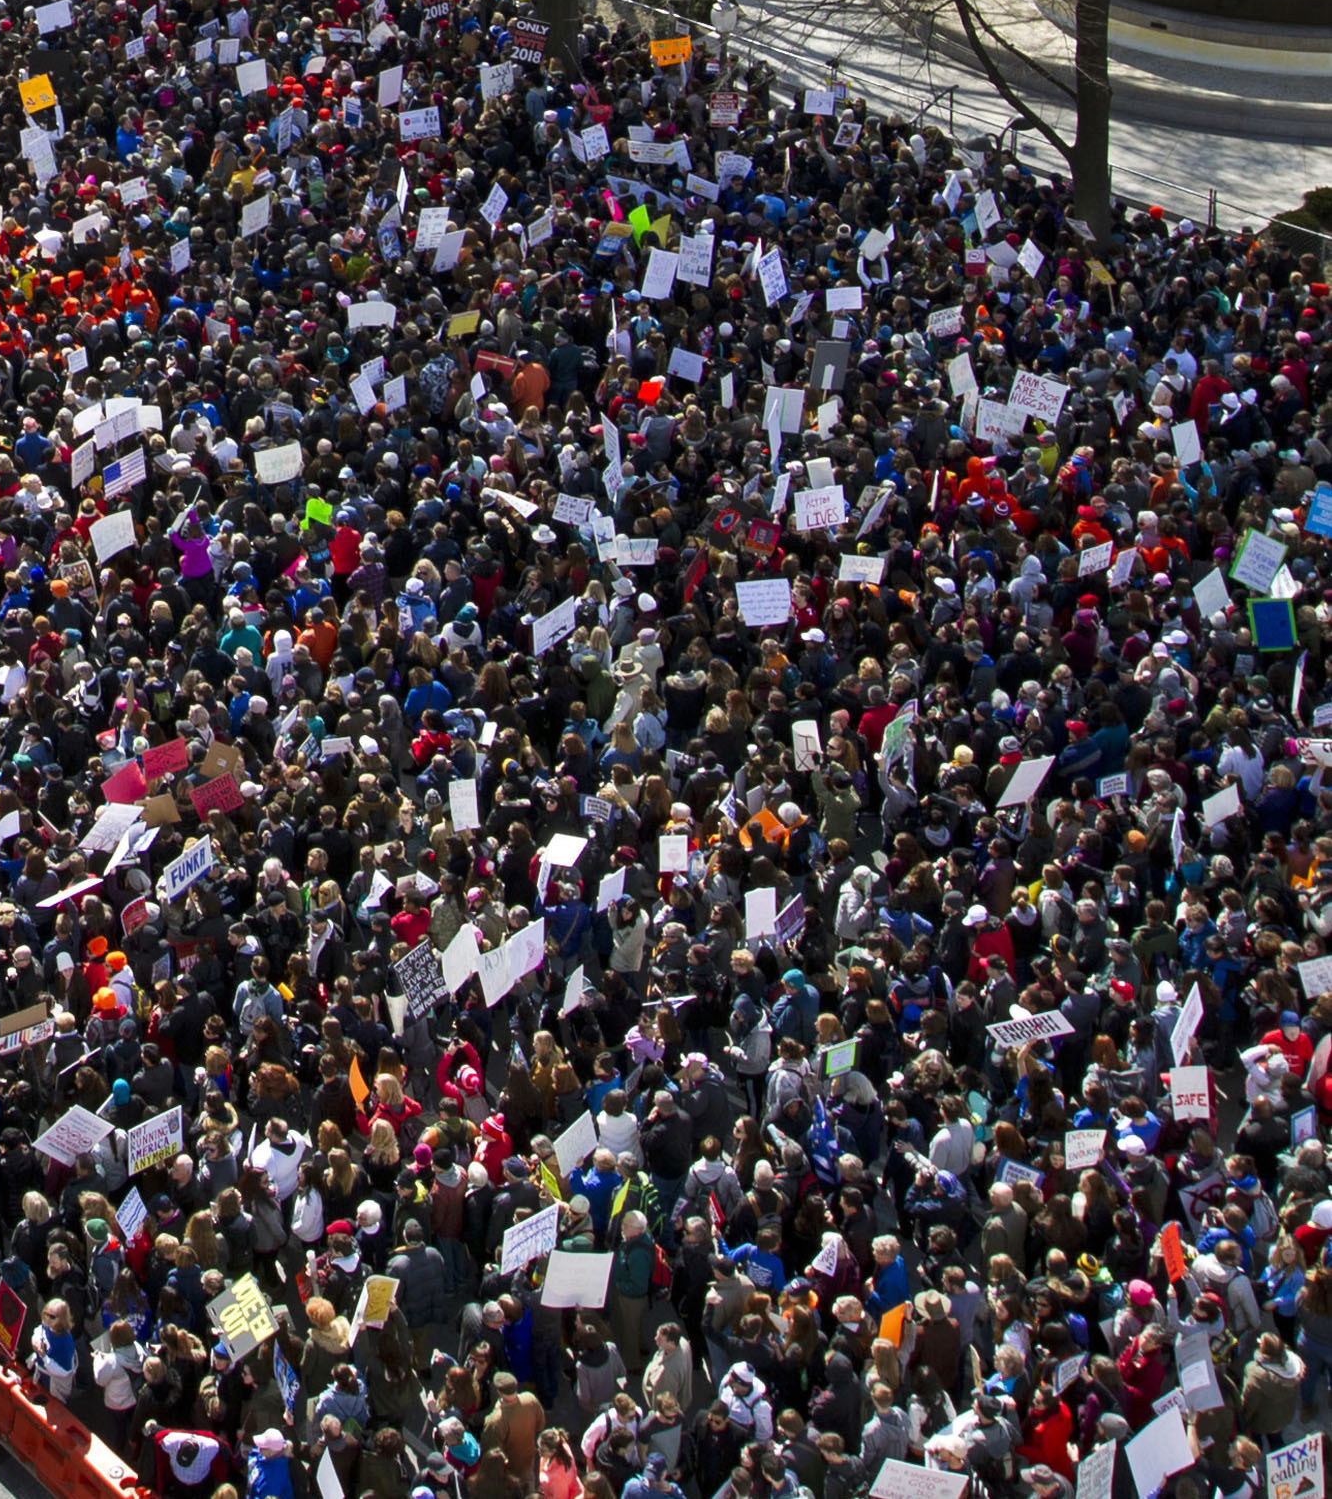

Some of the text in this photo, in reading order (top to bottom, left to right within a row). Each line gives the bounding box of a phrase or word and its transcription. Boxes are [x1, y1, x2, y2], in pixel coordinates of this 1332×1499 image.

[423, 3, 450, 21] 2018
[516, 20, 550, 36] ONLY
[510, 46, 543, 64] 2018
[1017, 374, 1047, 392] ARMS
[1010, 392, 1059, 417] HUGGING
[1015, 384, 1061, 405] ARE FOR
[806, 508, 840, 527] LIVES
[407, 941, 431, 966] MARCH
[415, 953, 432, 971] OUR
[405, 970, 425, 990] LIVES
[994, 1014, 1054, 1035] ENOUGH
[1000, 1020, 1061, 1044] ENOUGH
[1175, 1093, 1208, 1107] SAFE
[129, 1125, 147, 1140] NOT
[130, 1137, 170, 1162] AMERICA
[133, 1143, 178, 1171] ANYMORE
[231, 1274, 266, 1314] VOTE
[220, 1305, 248, 1341] OUT
[1271, 1456, 1317, 1484] calling
[908, 1480, 935, 1491] GOD
